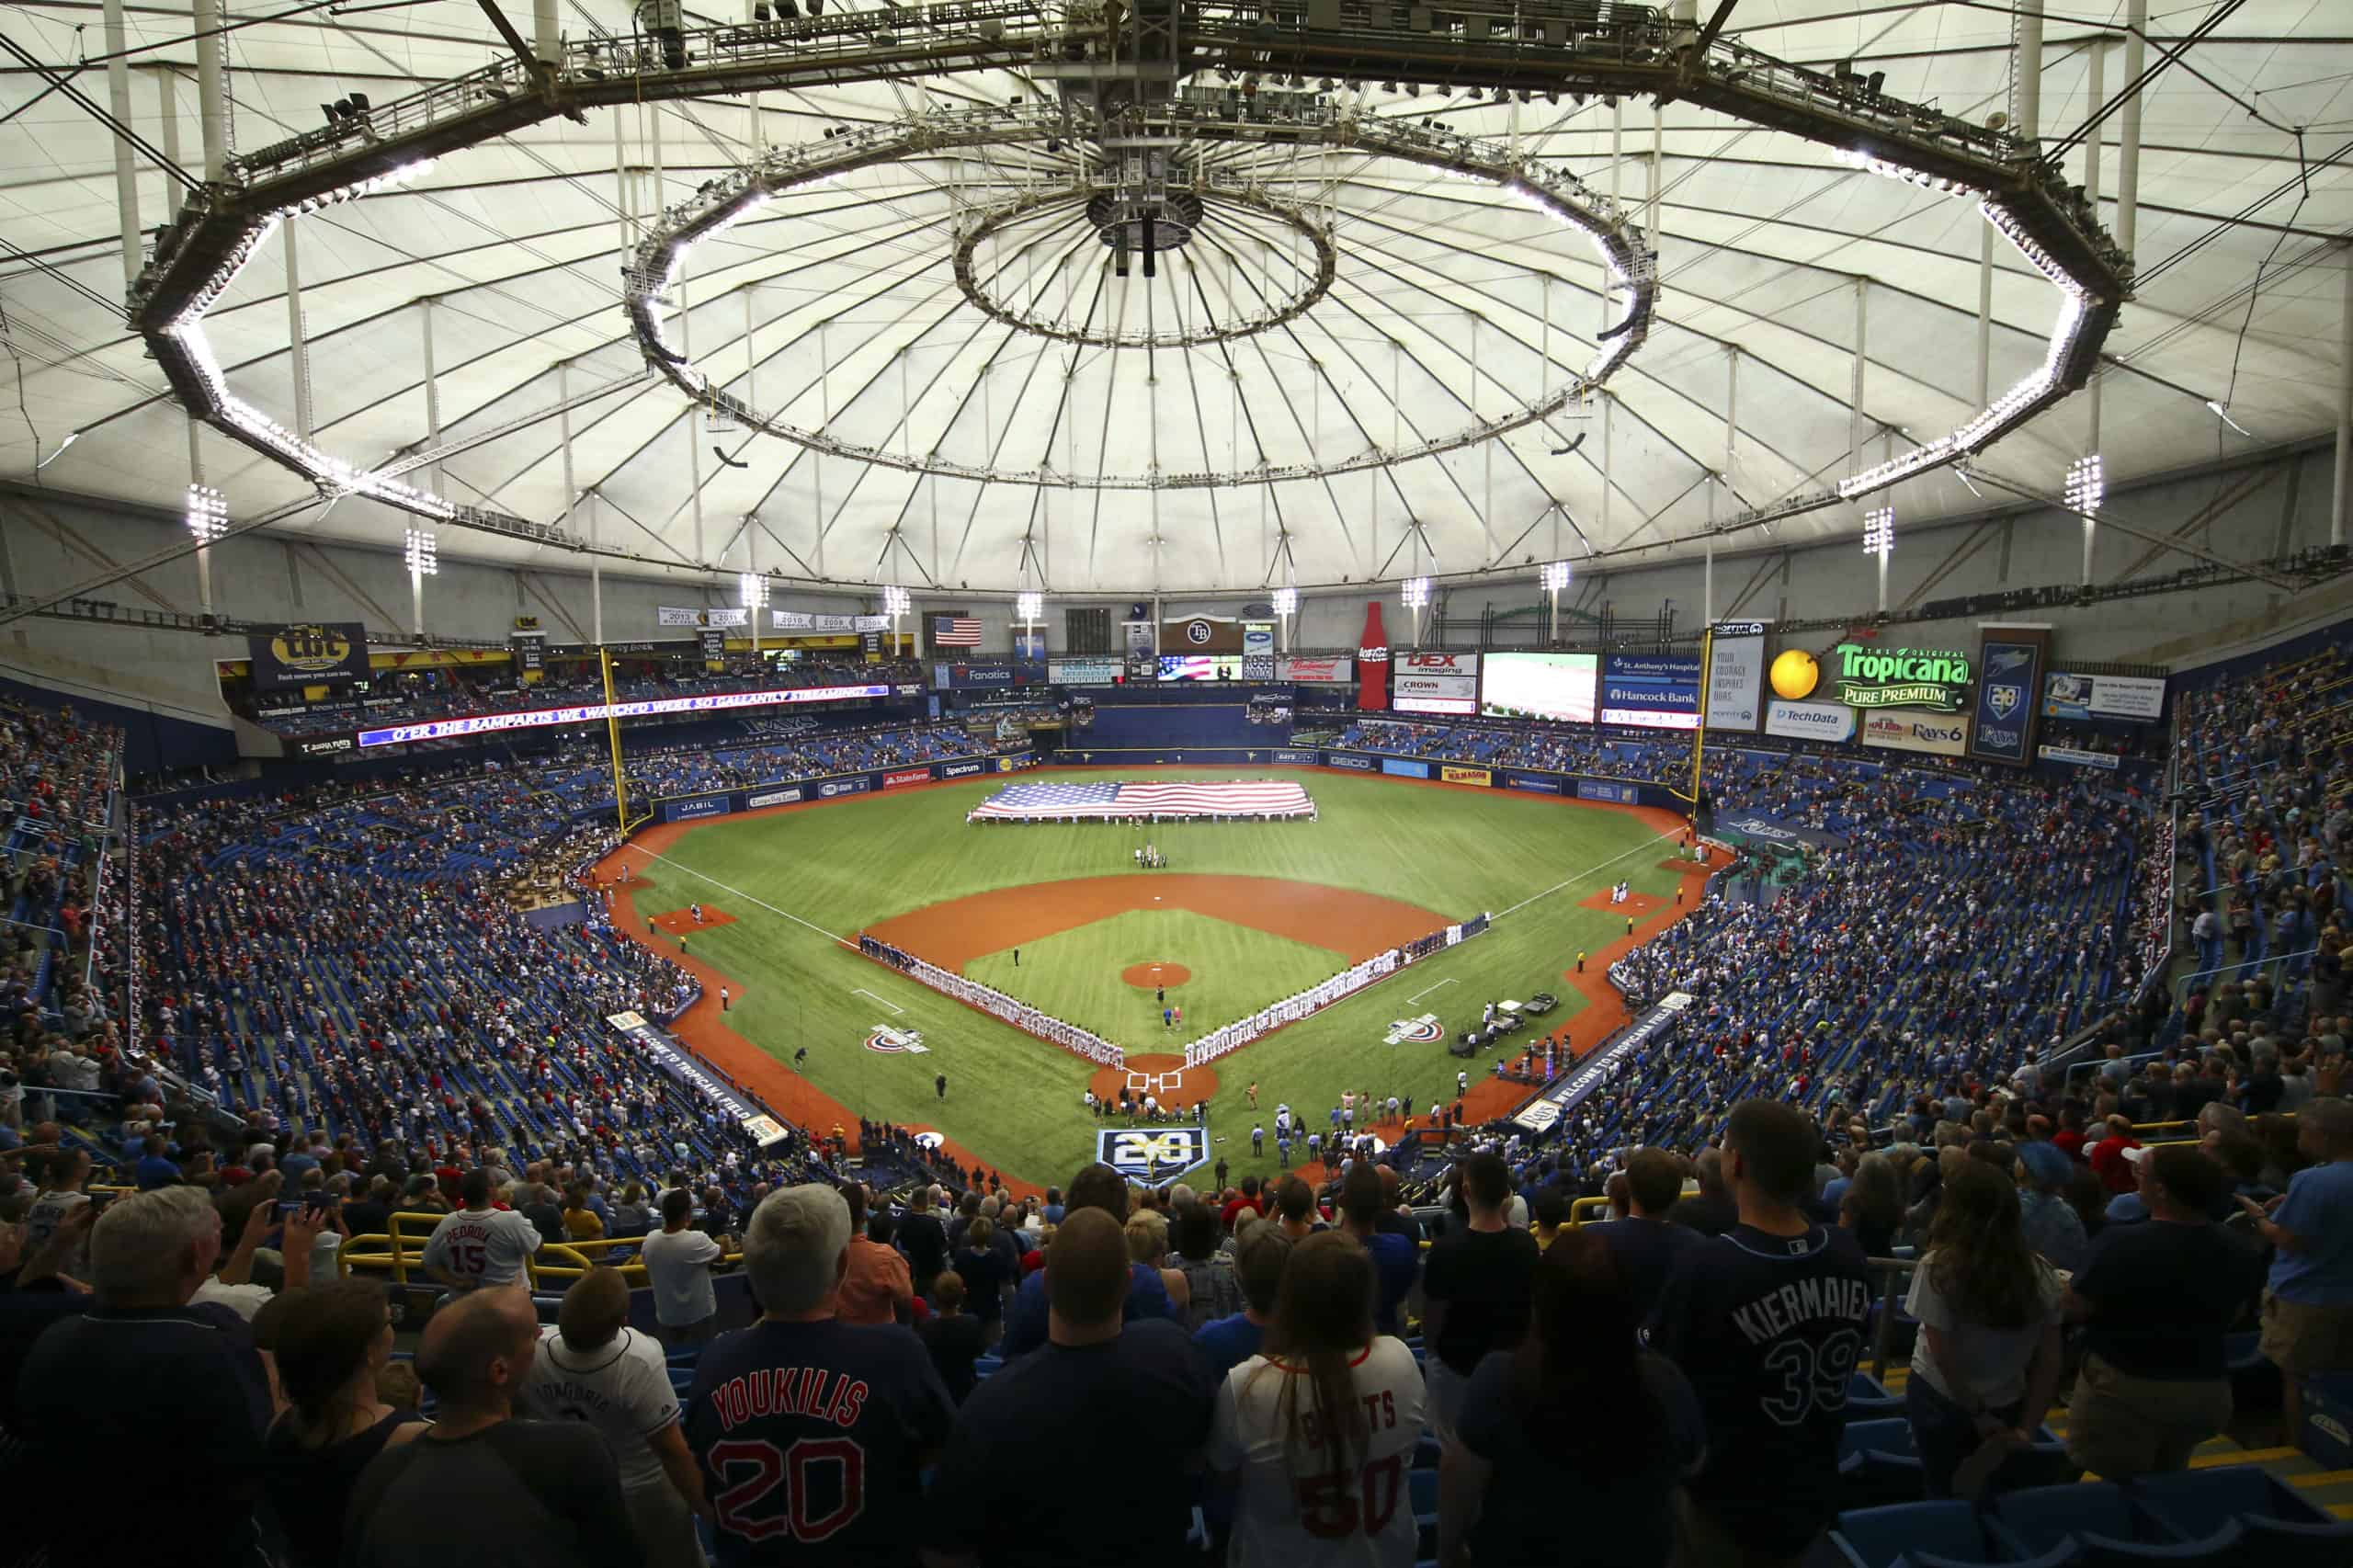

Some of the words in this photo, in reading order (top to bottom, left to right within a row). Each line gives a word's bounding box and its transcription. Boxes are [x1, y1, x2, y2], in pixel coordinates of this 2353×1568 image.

[1194, 624, 1207, 641] TB
[1407, 653, 1456, 667] DEX
[1911, 649, 1964, 657] ORIGINAL
[1244, 654, 1272, 668] ROSE
[1622, 662, 1632, 670] St.
[1633, 662, 1668, 672] Anthony's
[1669, 662, 1699, 672] Hospital
[1836, 643, 1969, 683] Tropicana
[969, 670, 1010, 681] Fanatics
[1417, 666, 1462, 675] imaging
[1404, 681, 1438, 689] CROWN
[1622, 692, 1667, 703] Hancock
[1668, 694, 1696, 704] Bank
[1845, 687, 1879, 704] PURE
[1881, 687, 1947, 702] PREMIUM
[435, 720, 465, 736] THE
[469, 712, 553, 732] RAMPARTS
[556, 710, 582, 722] WE
[1949, 726, 1962, 741] 6
[1330, 756, 1369, 768] GEICO
[946, 764, 979, 776] Spectrum
[681, 801, 714, 812] JABIL
[1552, 1066, 1601, 1104] WELCOME
[1599, 1058, 1611, 1069] TO
[1610, 1024, 1655, 1060] TROPICANA
[632, 1027, 672, 1056] WELCOME
[667, 1051, 681, 1062] TO
[676, 1061, 724, 1098] TROPICANA
[720, 1095, 751, 1119] FIELD
[449, 1245, 485, 1275] 15
[1760, 1328, 1861, 1426] 39
[710, 1366, 869, 1432] YOUKILIS
[707, 1436, 865, 1543] 20
